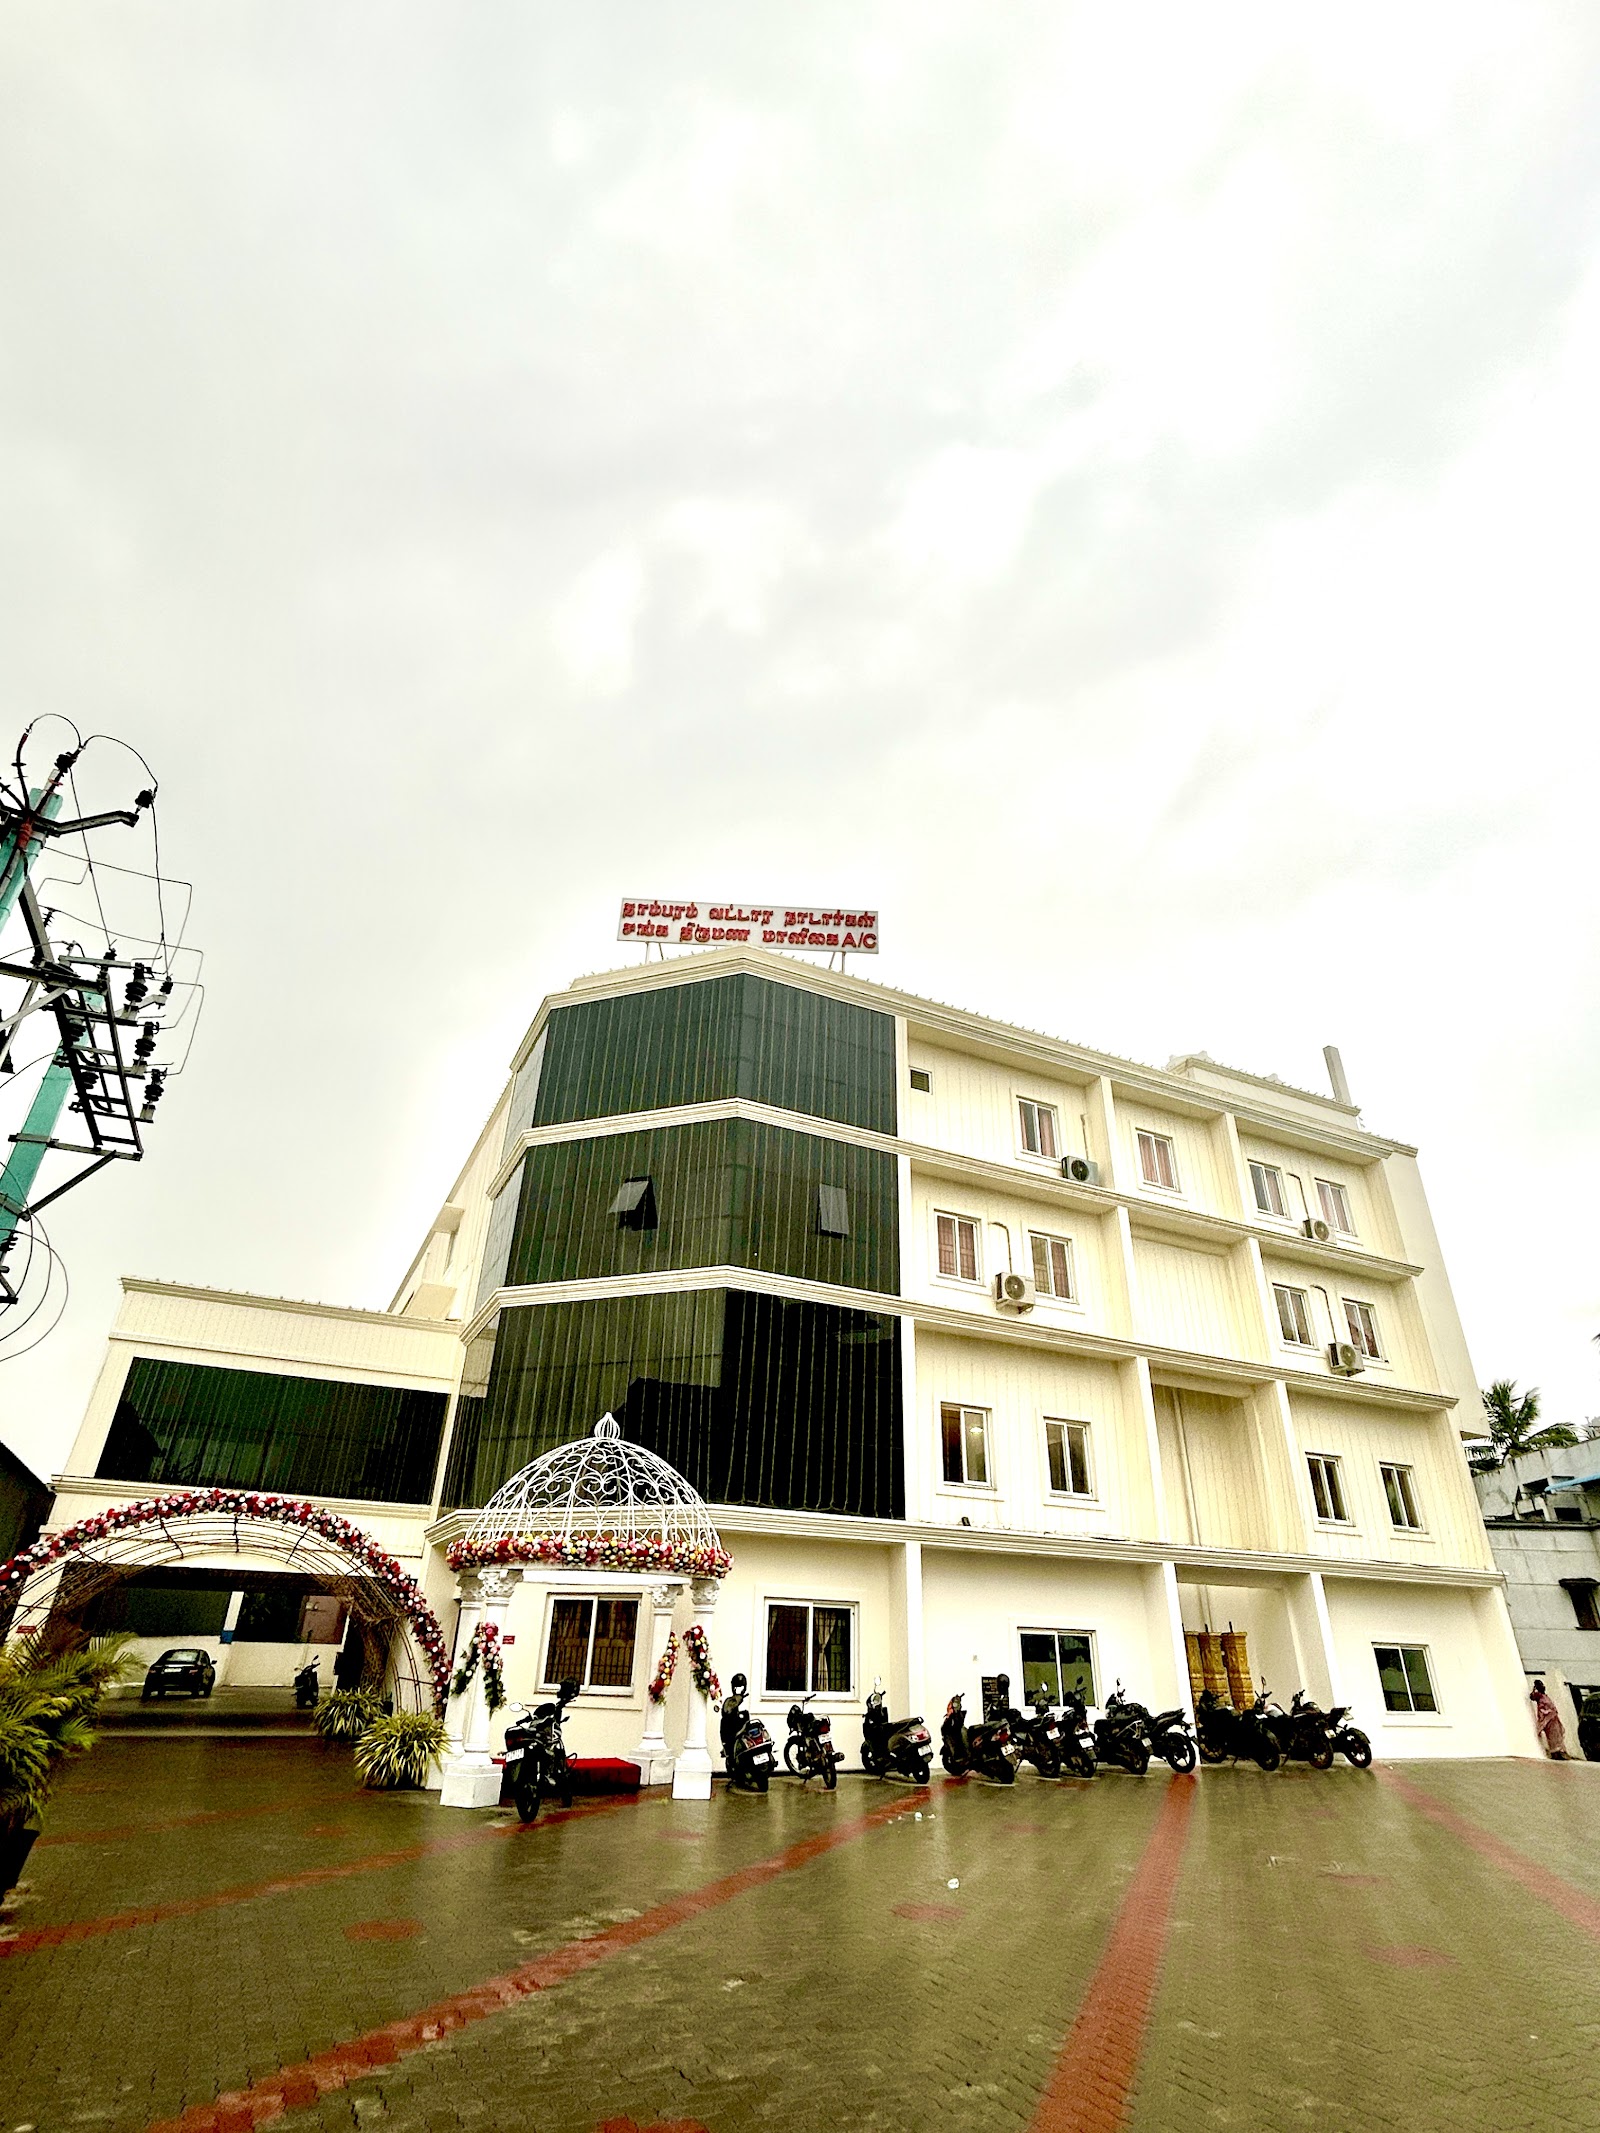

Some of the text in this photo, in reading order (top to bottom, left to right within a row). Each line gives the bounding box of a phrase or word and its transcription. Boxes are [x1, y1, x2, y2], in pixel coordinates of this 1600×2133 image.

[622, 900, 876, 927] தாம்பரம் வட்டார நாடார்கள்
[622, 919, 669, 937] சங்க
[679, 922, 750, 942] திருமண
[841, 932, 877, 949] A/C
